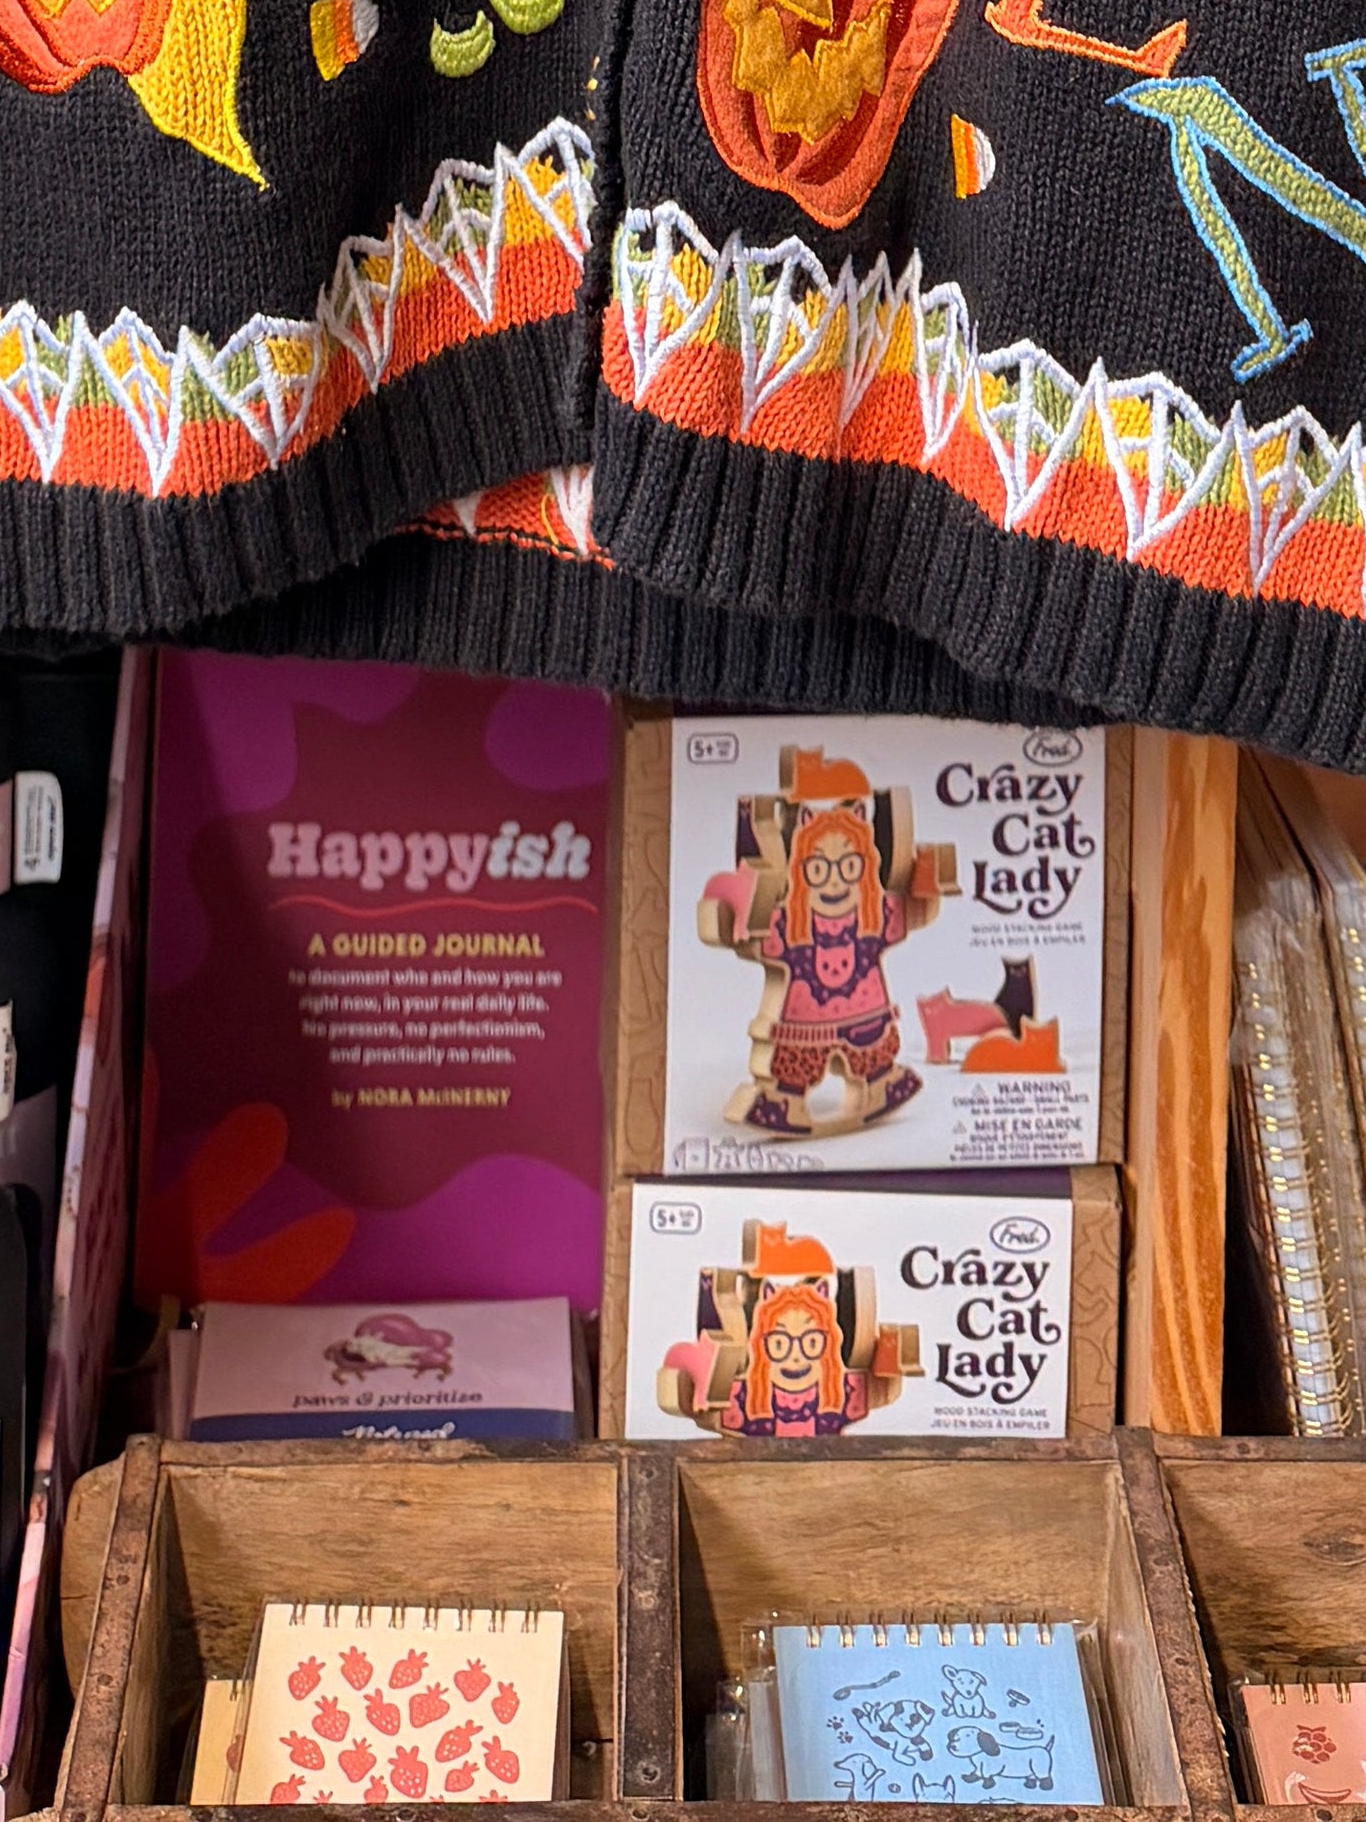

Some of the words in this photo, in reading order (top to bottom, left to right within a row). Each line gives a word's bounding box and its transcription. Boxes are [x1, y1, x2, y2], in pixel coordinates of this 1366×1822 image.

[936, 763, 1084, 816] Crazy
[267, 820, 591, 893] Happyish
[993, 812, 1096, 858] Cat
[973, 855, 1082, 920] Lady
[308, 933, 326, 957] A
[333, 933, 427, 957] GUIDED
[432, 933, 545, 957] JOURNAL
[308, 967, 390, 986] document
[432, 967, 462, 985] and
[464, 967, 500, 985] how
[502, 970, 533, 989] you
[536, 970, 562, 986] are
[329, 1046, 360, 1063] and
[357, 1087, 414, 1106] NORA
[901, 1246, 1050, 1302] Crazy
[957, 1298, 1061, 1346] Cat
[935, 1341, 1047, 1404] Lady
[293, 1393, 349, 1408] paws
[1019, 1408, 1047, 1418] GAME
